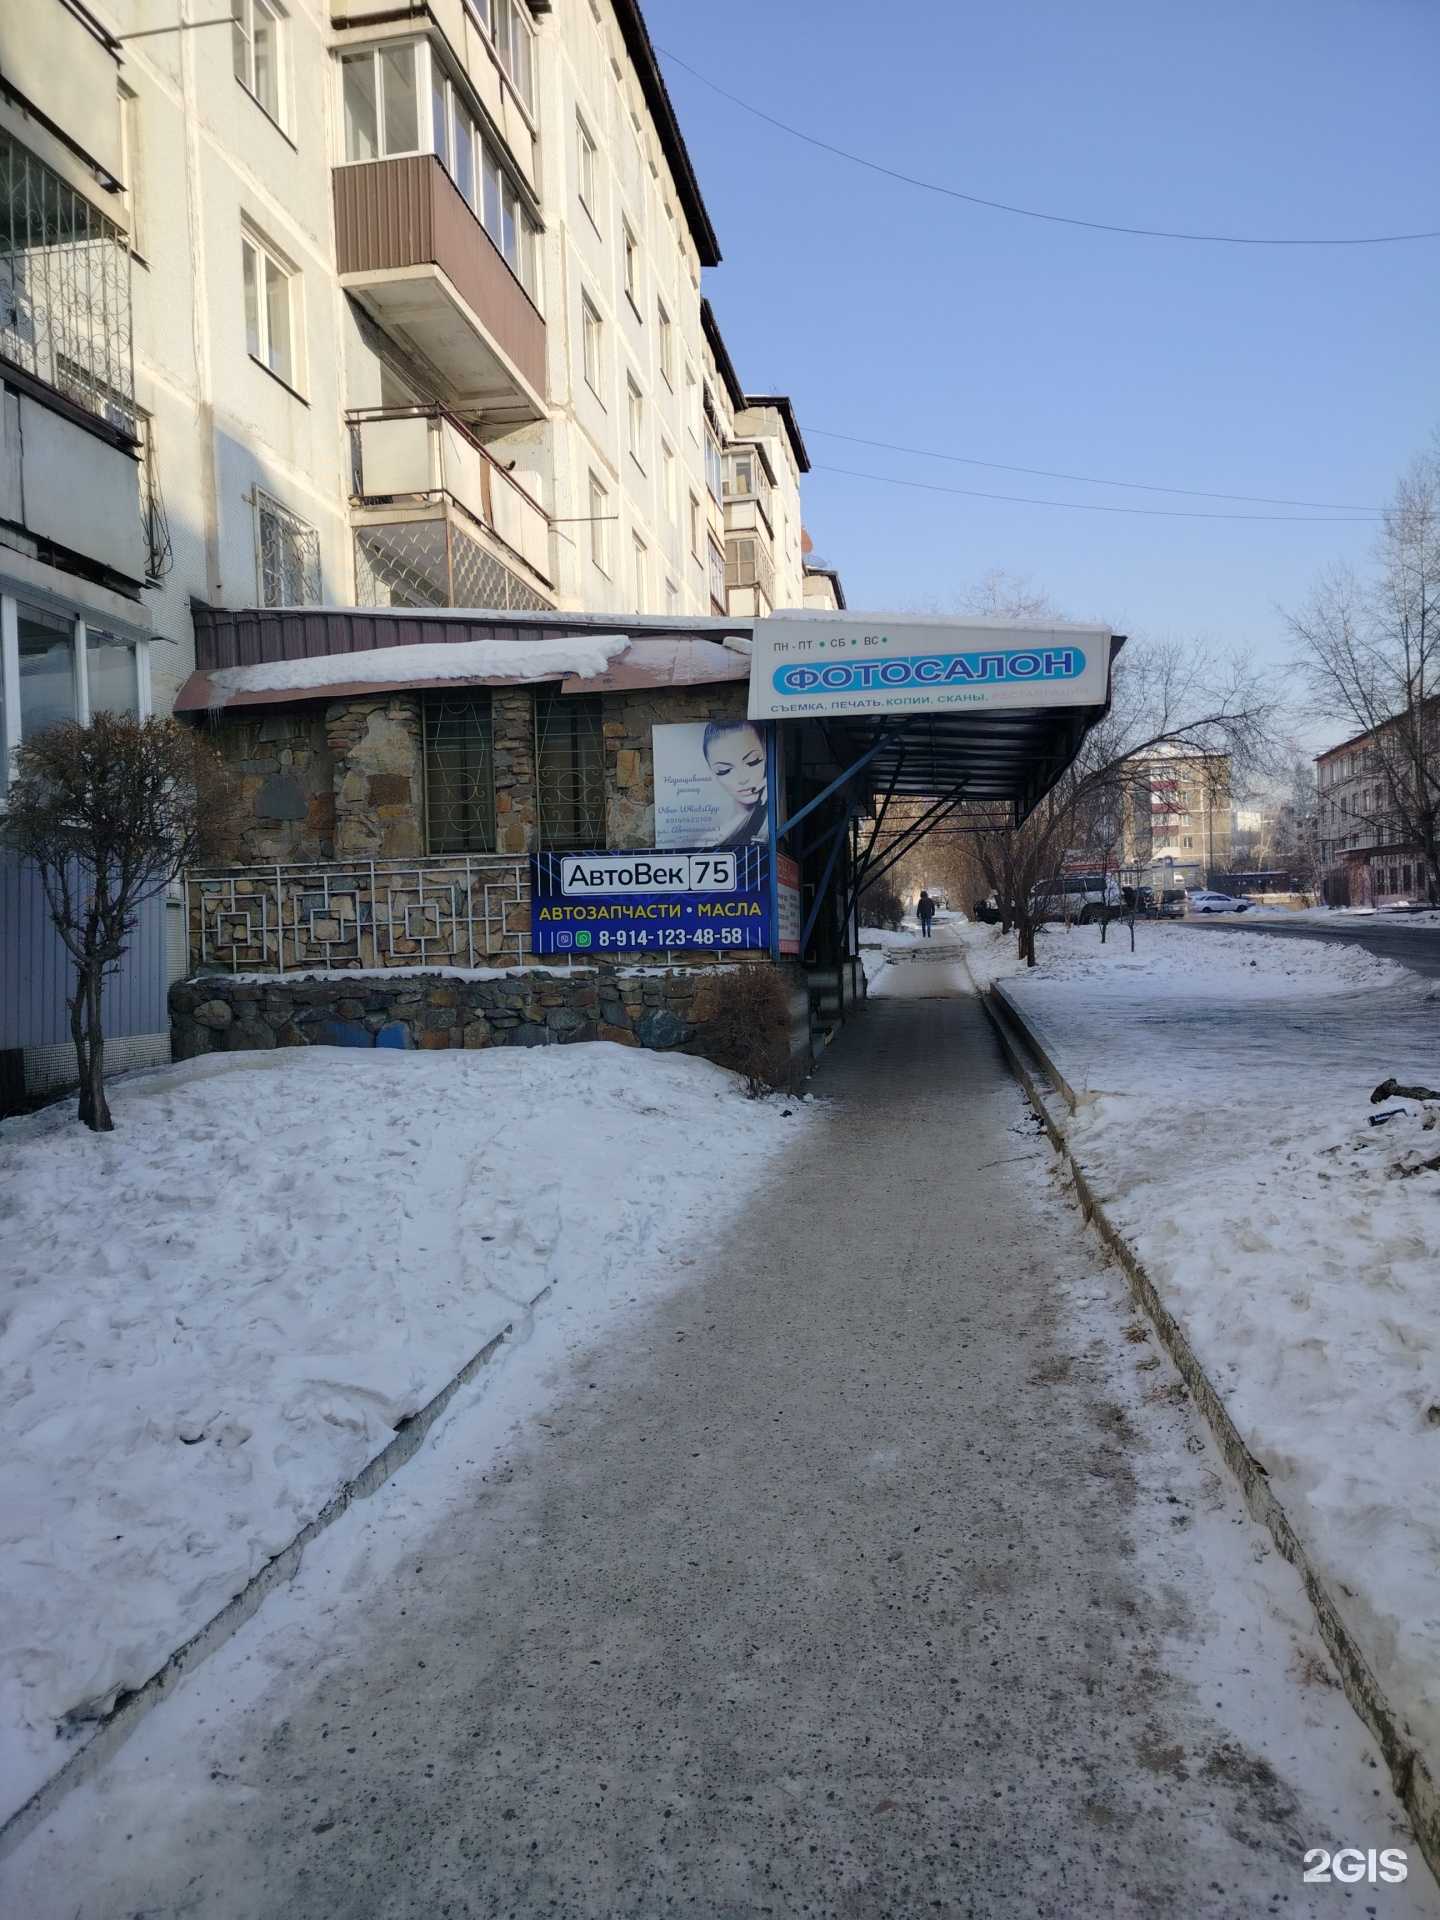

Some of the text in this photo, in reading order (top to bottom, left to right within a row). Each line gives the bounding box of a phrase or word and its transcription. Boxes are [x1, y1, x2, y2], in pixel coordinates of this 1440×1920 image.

[773, 642, 789, 652] ПН
[830, 638, 846, 648] СБ
[864, 636, 879, 646] ВС
[784, 651, 1073, 691] ФОТОСАЛОН
[568, 861, 729, 887] АвтоВек 75
[539, 902, 762, 921] АВТОЗАПЧАСТИ МАСЛА
[599, 928, 742, 946] 8-914-123-48-58
